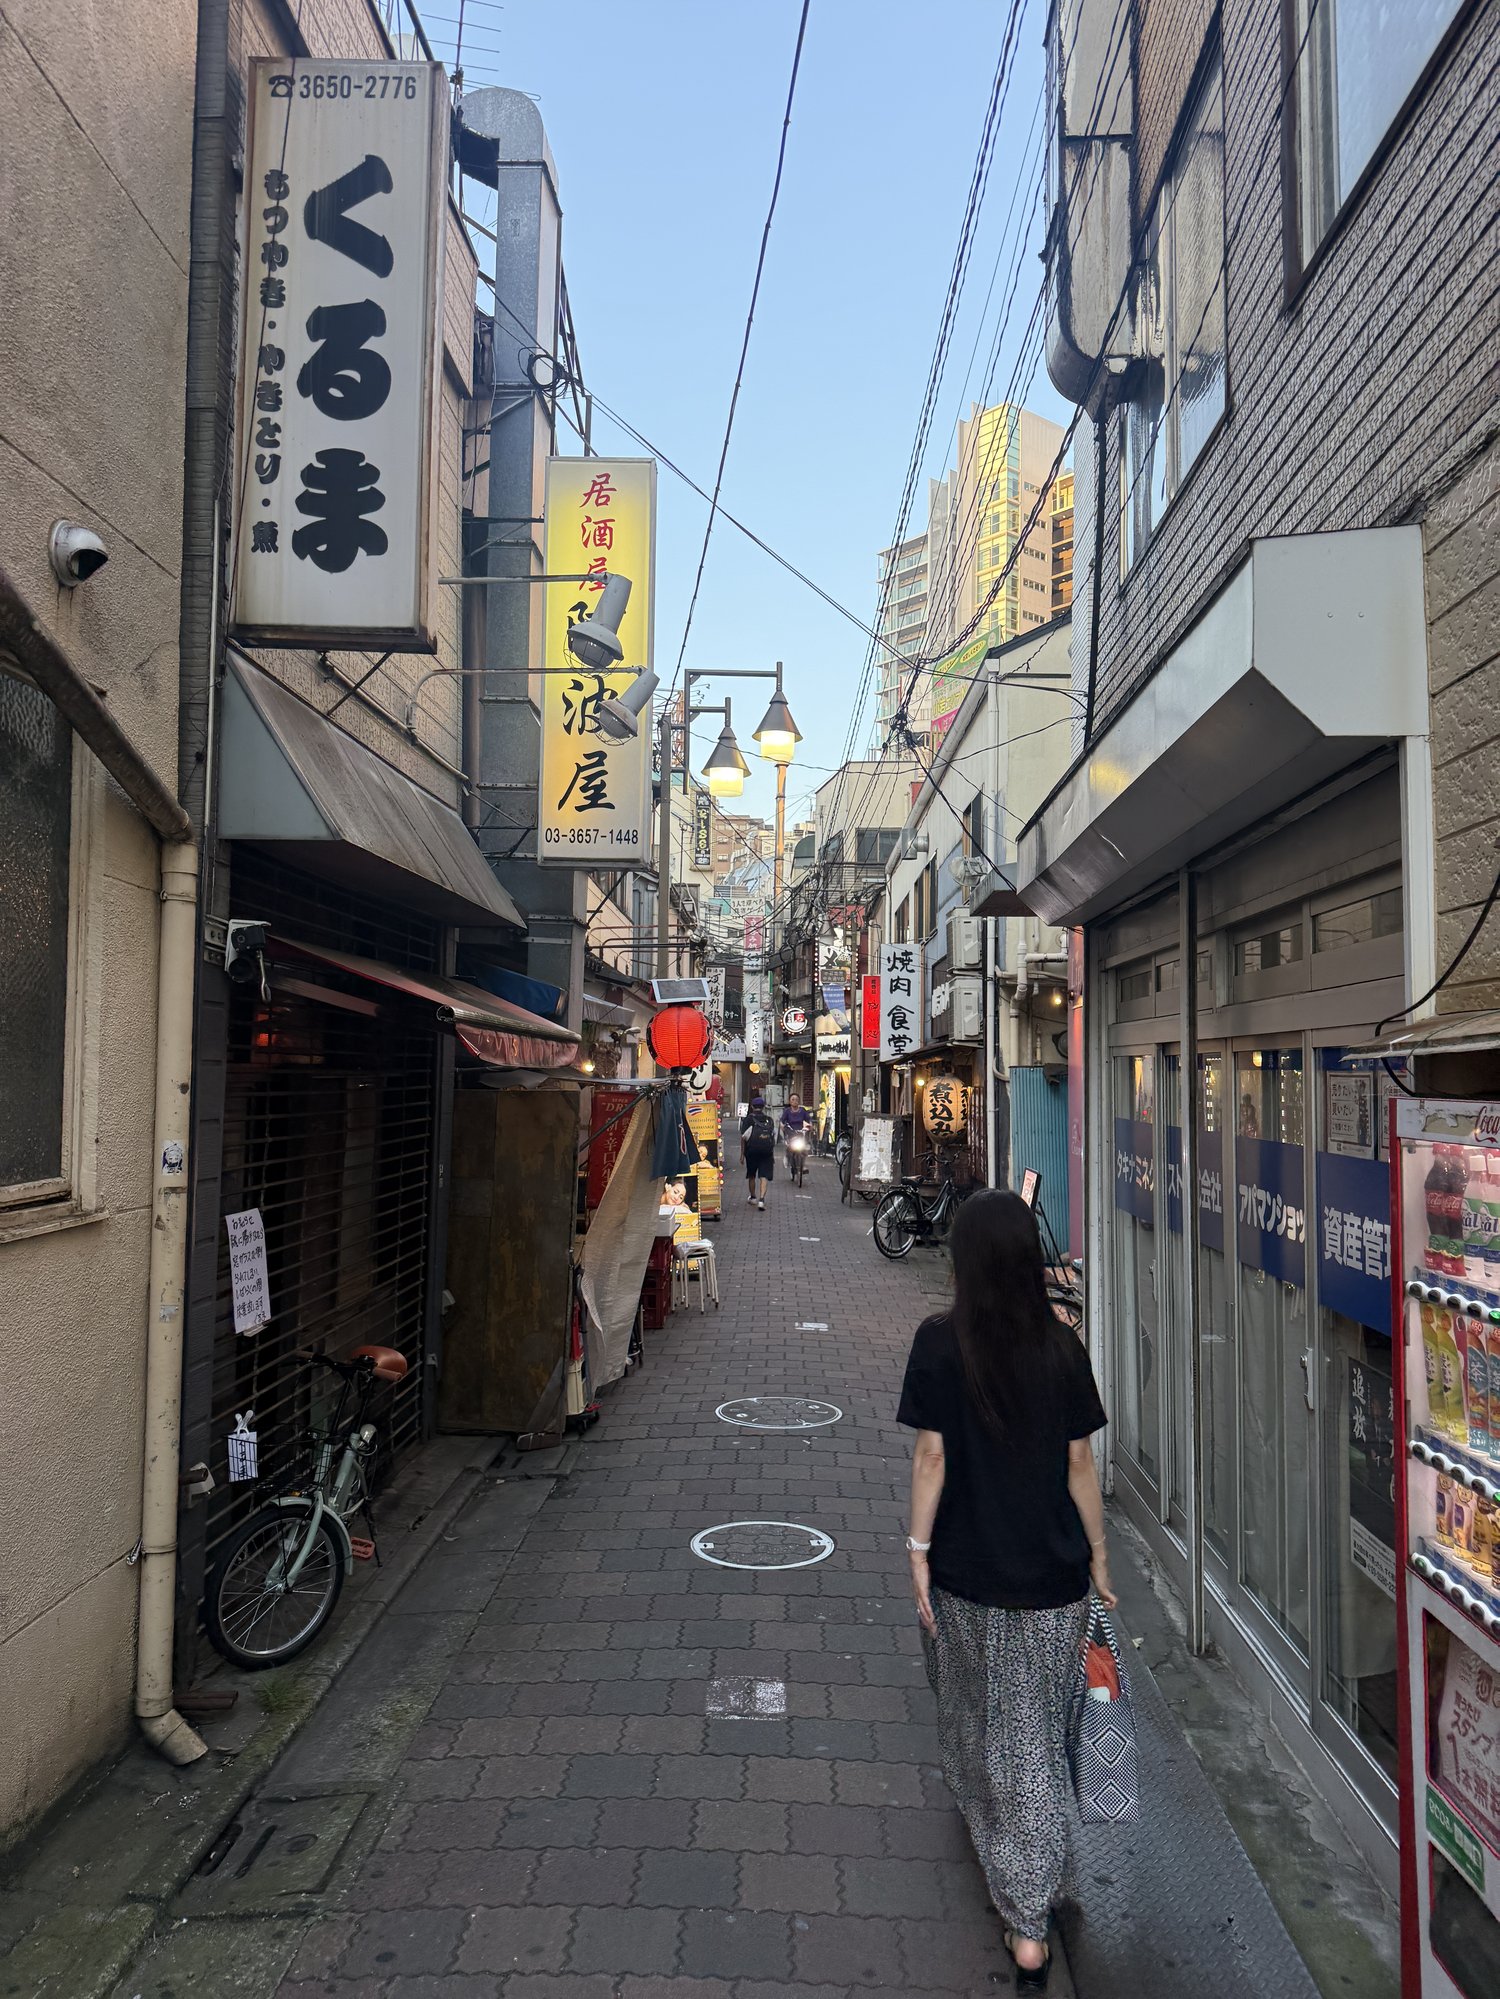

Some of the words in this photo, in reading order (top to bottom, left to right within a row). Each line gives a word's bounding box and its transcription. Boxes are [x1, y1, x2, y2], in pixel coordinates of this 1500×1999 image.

[299, 74, 417, 100] 3650-2776
[251, 168, 290, 554] もつやき・やきとり・魚
[292, 155, 395, 574] くるま
[579, 473, 617, 592] 居酒屋
[544, 828, 639, 846] 03-3657-1448
[886, 949, 916, 1057] 焼肉食堂
[929, 1082, 955, 1136] 煮込み
[1351, 1368, 1367, 1443] 追放
